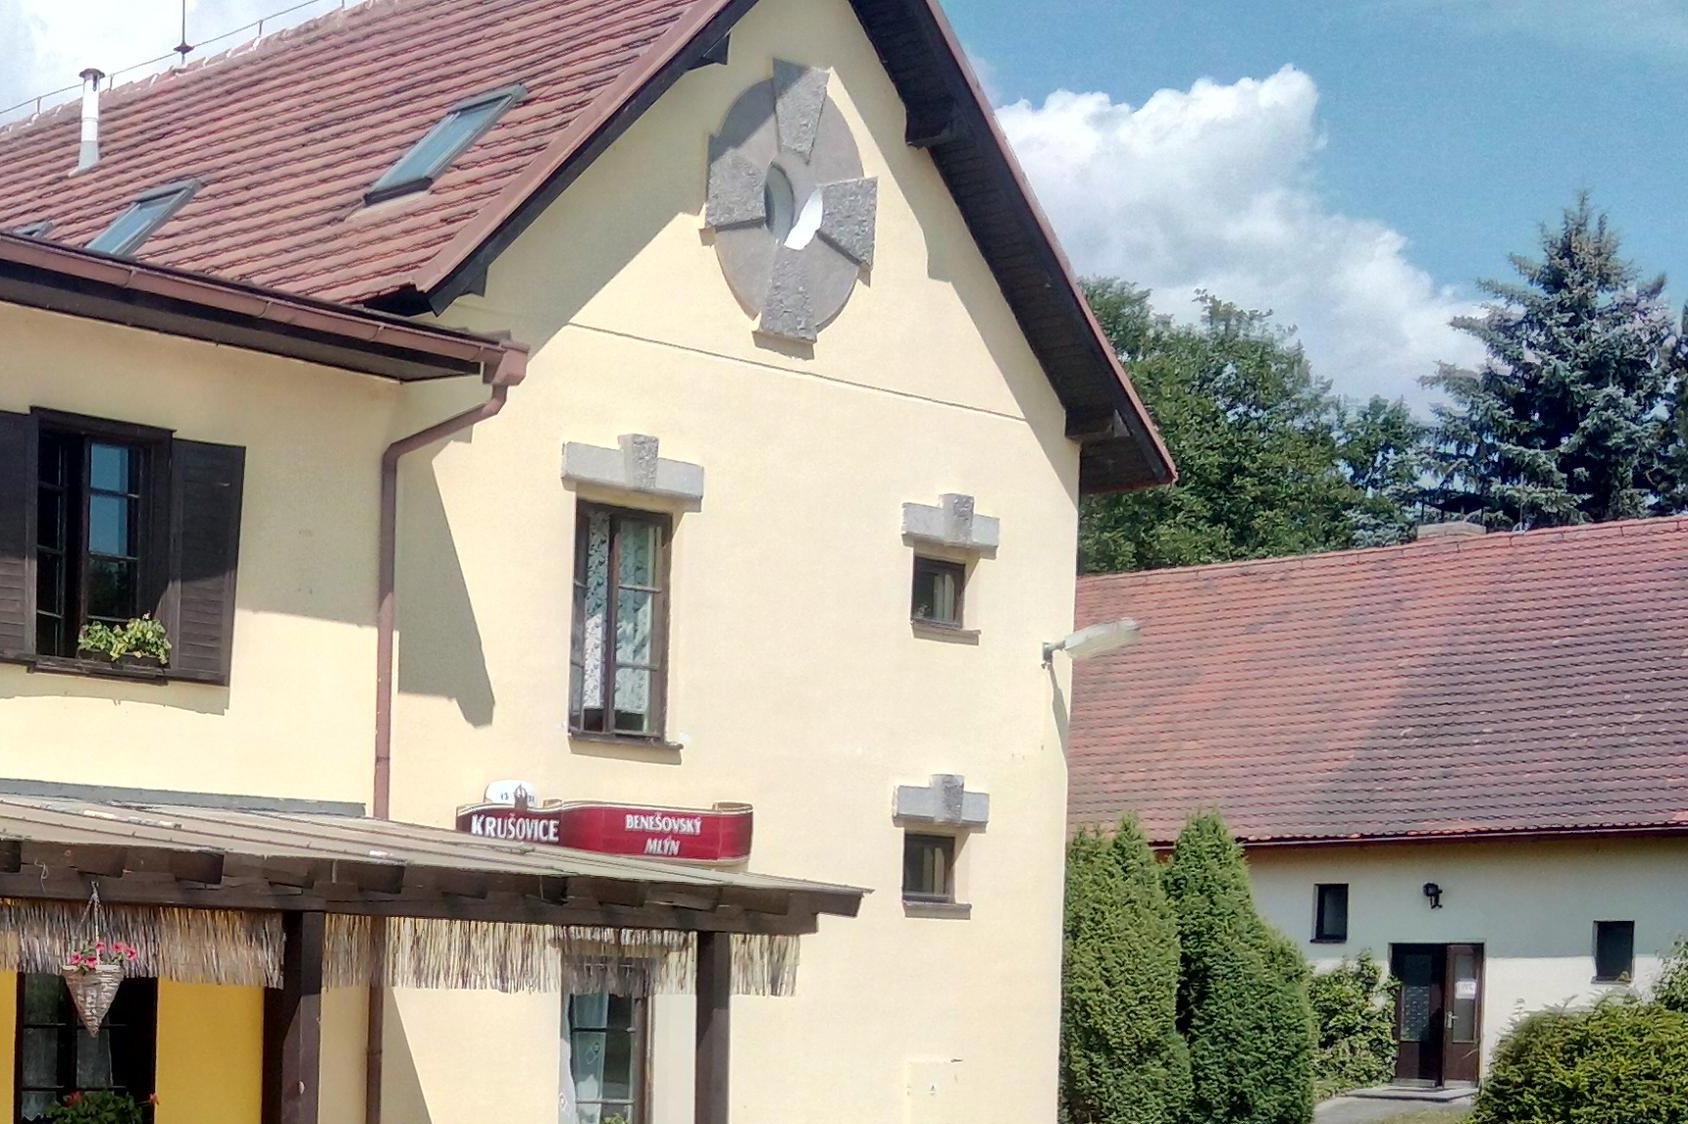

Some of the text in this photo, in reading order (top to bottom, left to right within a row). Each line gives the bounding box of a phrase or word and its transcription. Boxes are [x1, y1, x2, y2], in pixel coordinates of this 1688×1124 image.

[471, 811, 560, 842] KRUŠOVICE
[625, 812, 702, 835] BENEŠOVSKÝ
[643, 835, 681, 856] MLÝN
